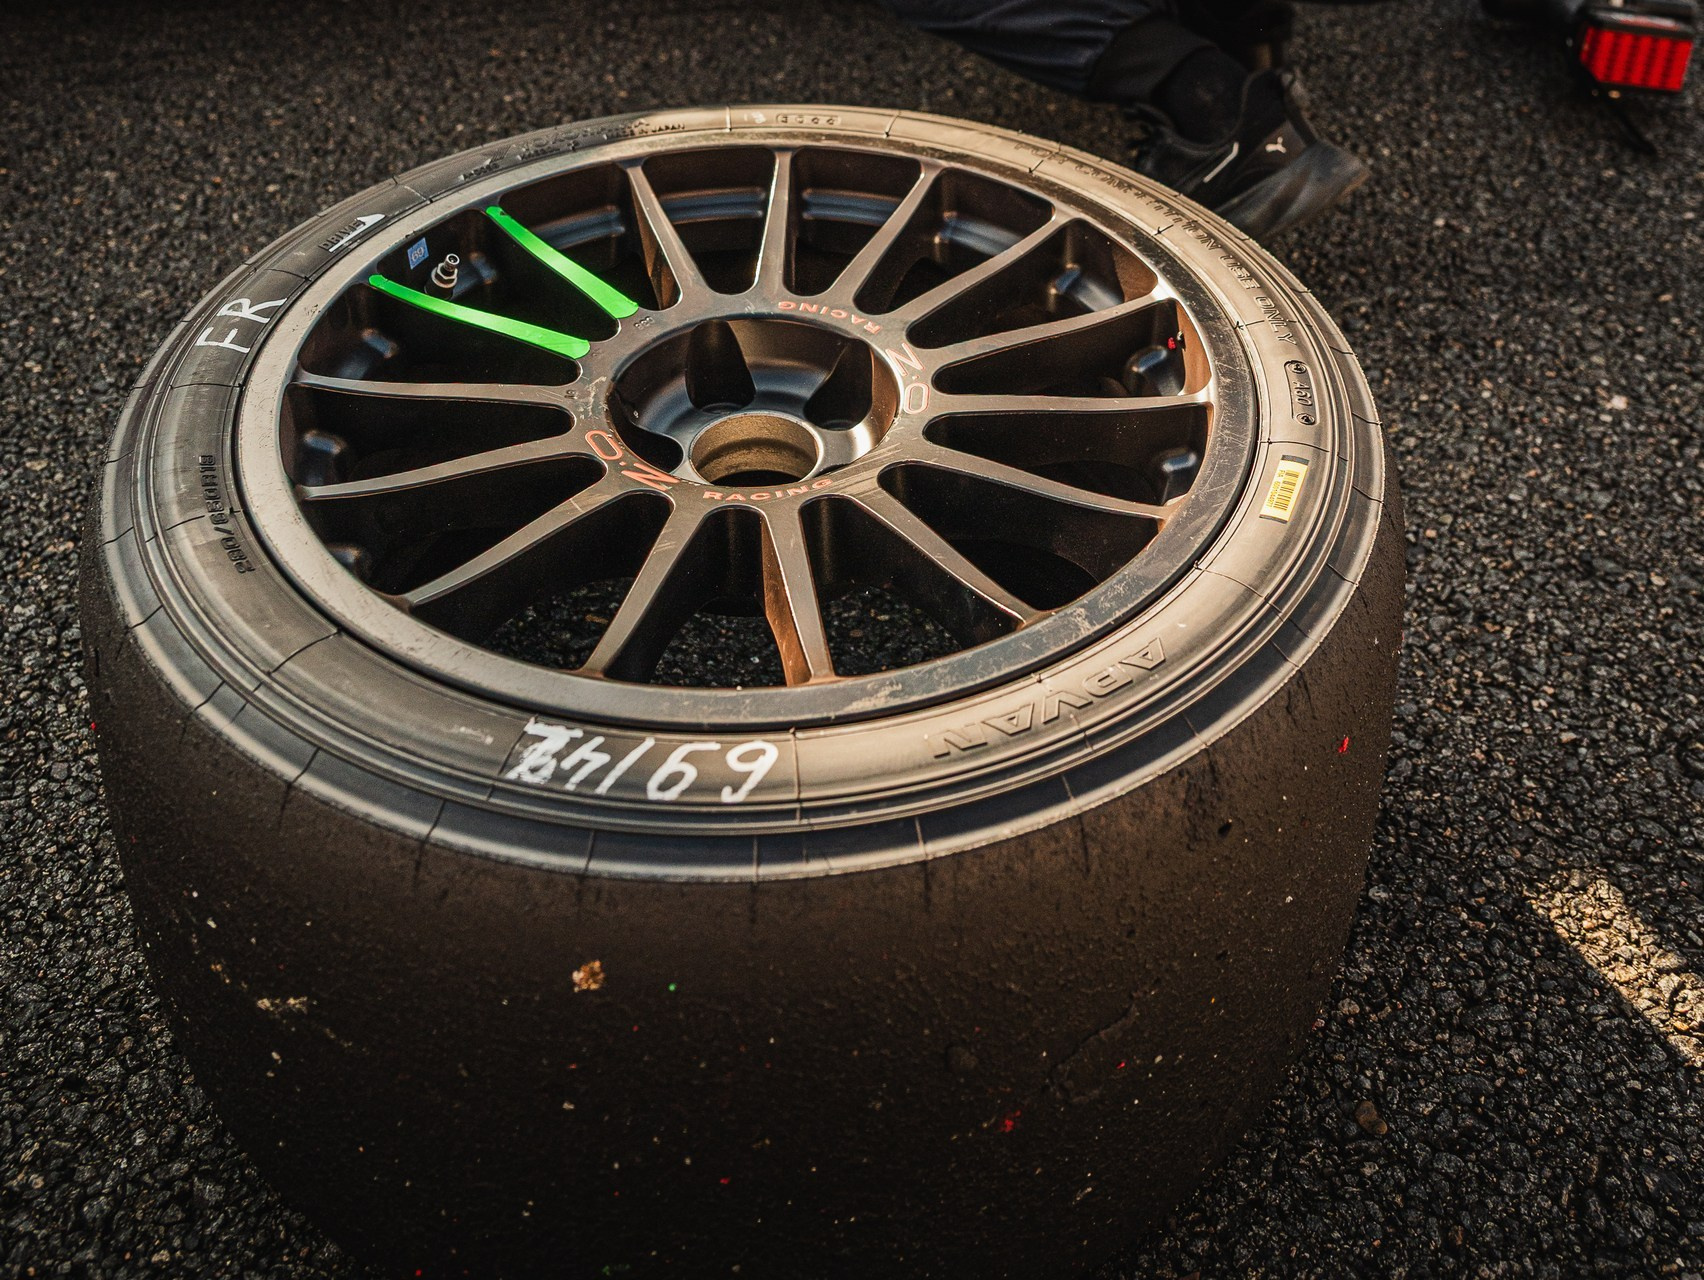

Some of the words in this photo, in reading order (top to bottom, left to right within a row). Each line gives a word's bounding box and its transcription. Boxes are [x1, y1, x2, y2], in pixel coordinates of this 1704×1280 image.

[318, 218, 366, 251] DRIVE
[411, 246, 425, 262] 69
[777, 300, 882, 335] RACING
[1219, 254, 1261, 290] USE
[1254, 295, 1298, 346] ONLY
[195, 297, 288, 355] FR
[702, 478, 834, 501] RACING
[924, 636, 1167, 759] ADVAN
